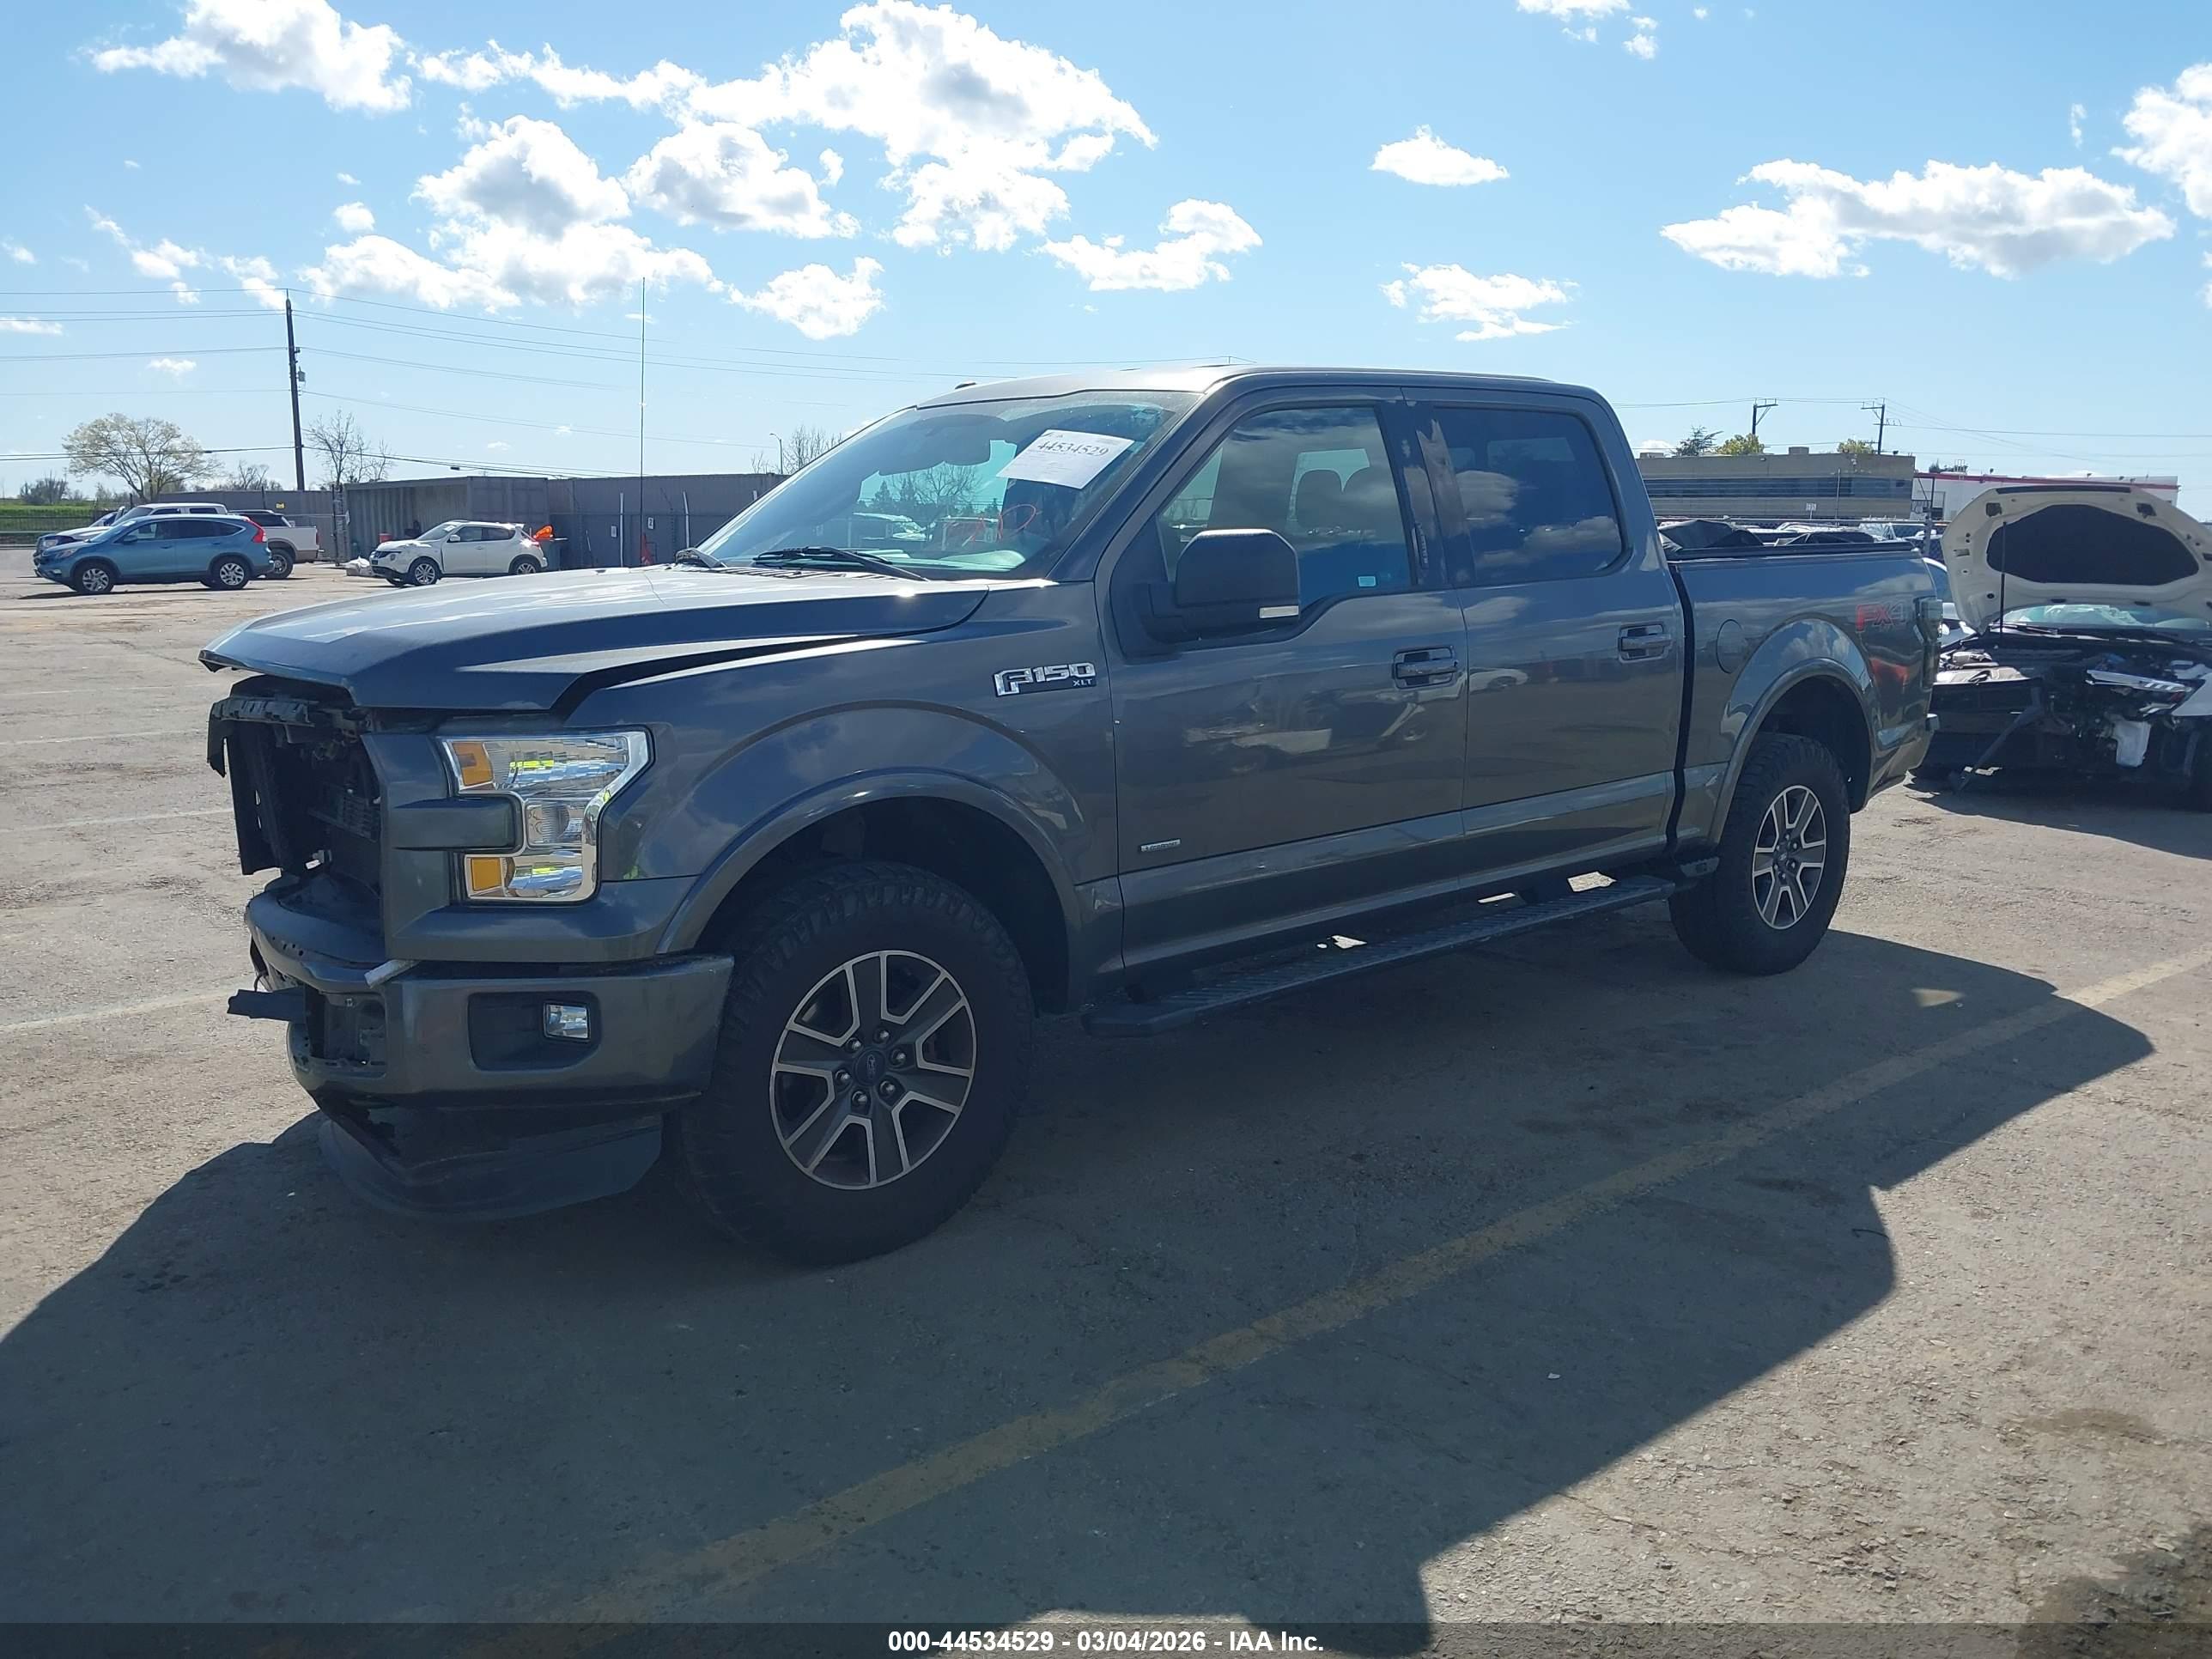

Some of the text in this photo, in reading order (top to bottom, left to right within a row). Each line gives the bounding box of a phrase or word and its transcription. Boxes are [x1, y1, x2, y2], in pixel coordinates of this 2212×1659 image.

[1036, 441, 1109, 457] 44534529
[1856, 602, 1906, 633] FX4
[1073, 678, 1093, 687] XLT
